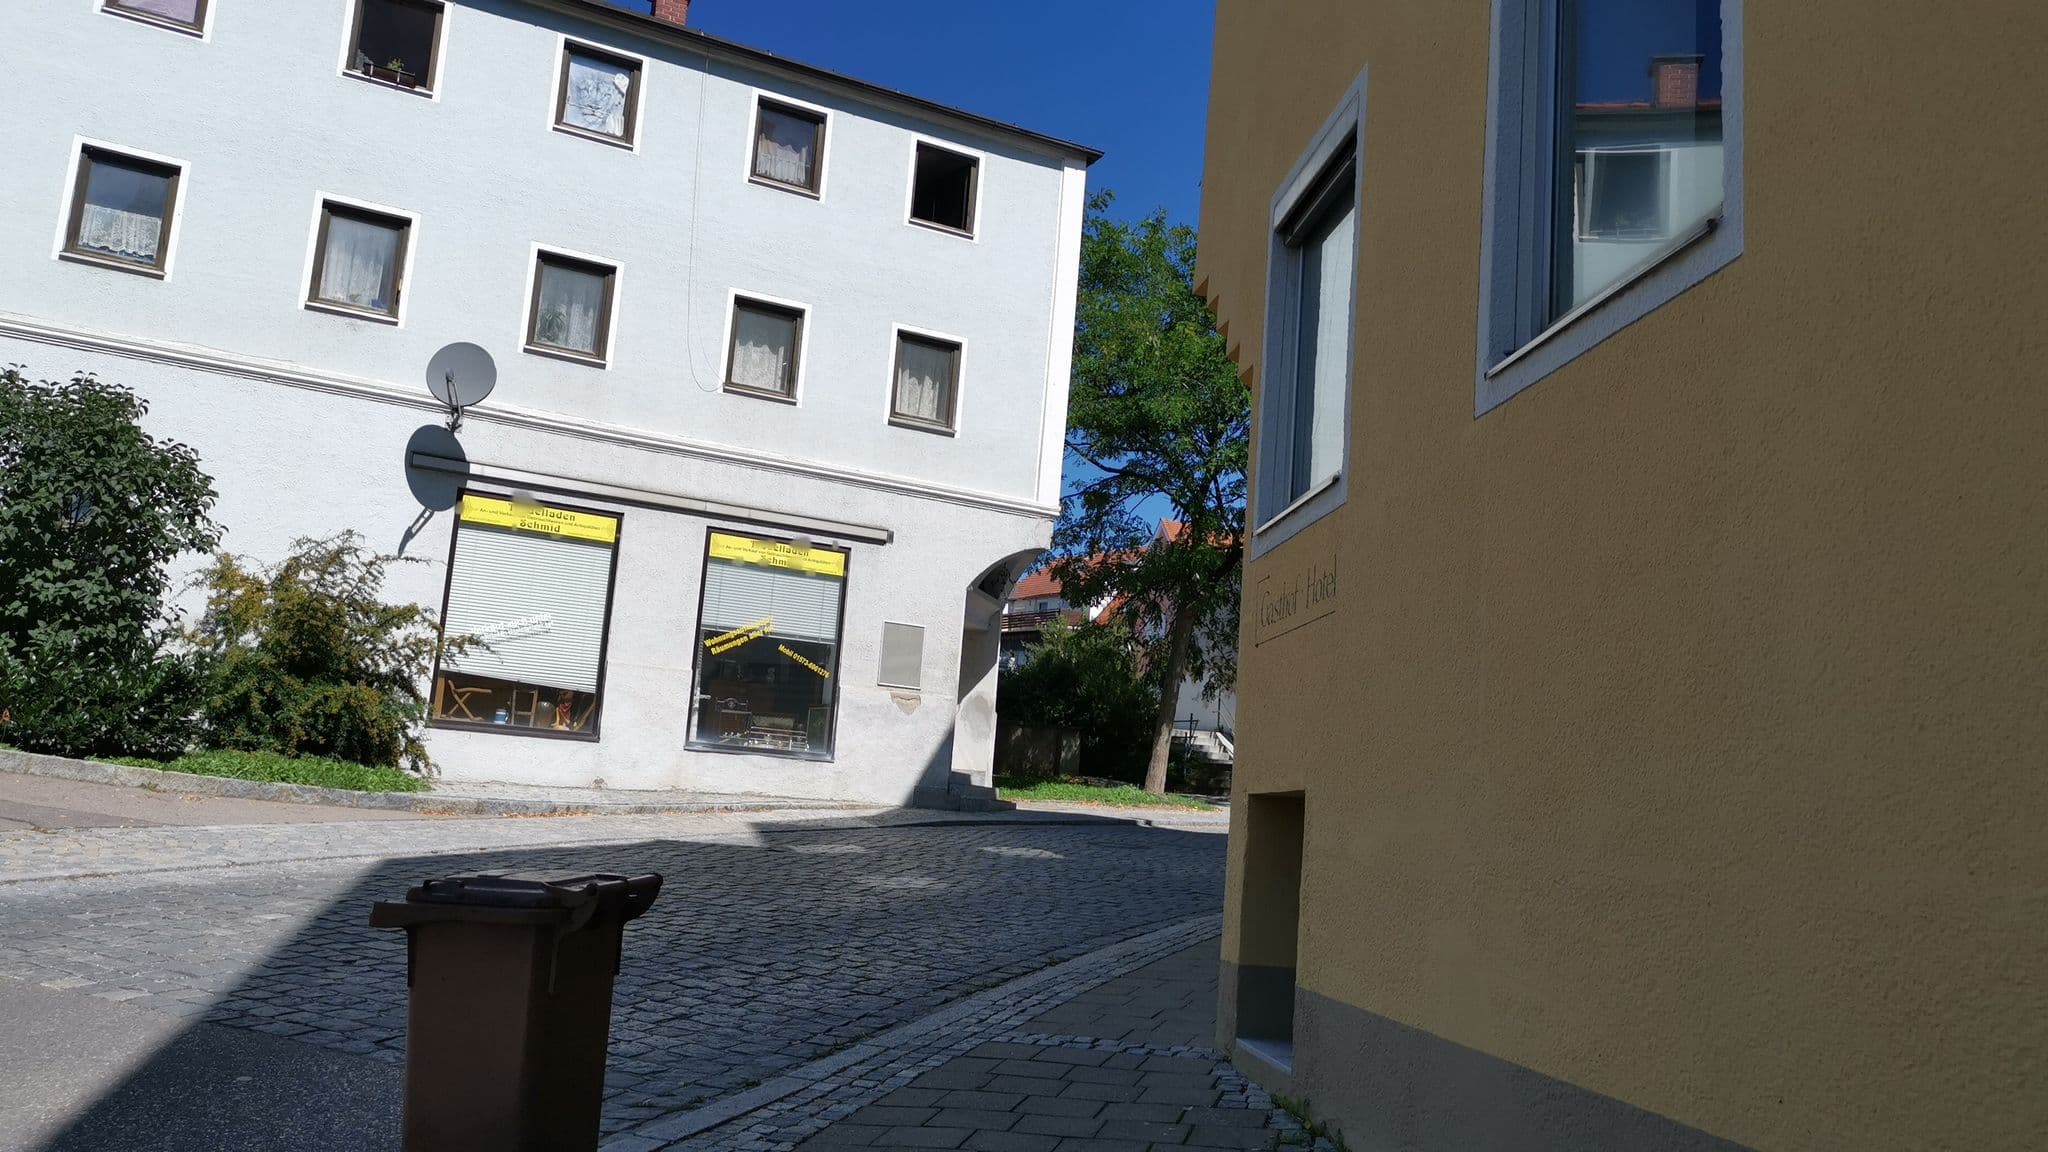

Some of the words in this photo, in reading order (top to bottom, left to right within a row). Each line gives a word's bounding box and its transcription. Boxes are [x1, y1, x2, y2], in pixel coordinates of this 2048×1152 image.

[519, 518, 560, 533] Schmid
[1306, 553, 1337, 609] Hotel
[777, 643, 794, 657] Mobil
